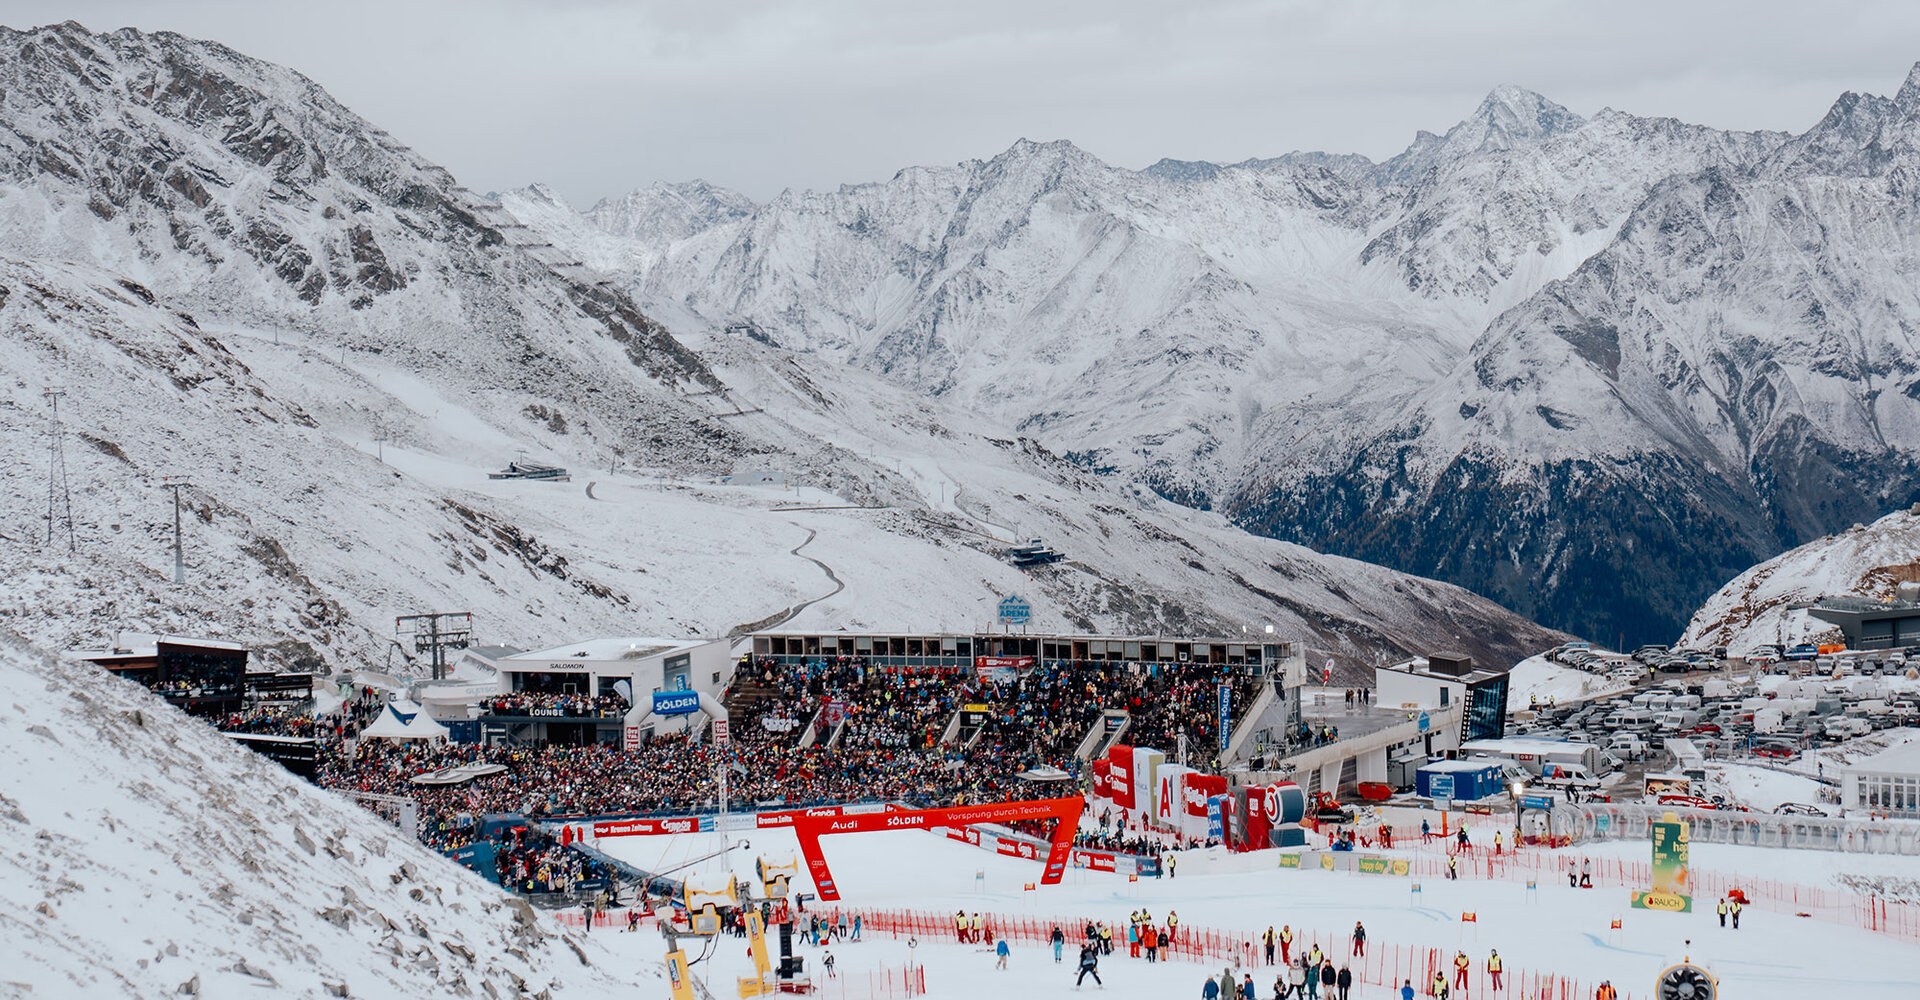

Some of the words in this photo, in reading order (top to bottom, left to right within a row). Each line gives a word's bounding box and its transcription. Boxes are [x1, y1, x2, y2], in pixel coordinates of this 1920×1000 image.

[656, 697, 697, 711] SÖLDEN
[529, 708, 564, 716] LOUNGE
[1160, 774, 1174, 818] A1
[947, 810, 991, 821] Vorsprung
[993, 807, 1018, 816] durch
[1019, 805, 1052, 814] Technik
[831, 820, 857, 830] Audi
[887, 816, 924, 826] SÖLDEN
[1360, 859, 1375, 872] happy
[1375, 862, 1385, 873] day
[1654, 897, 1681, 908] RAUCH
